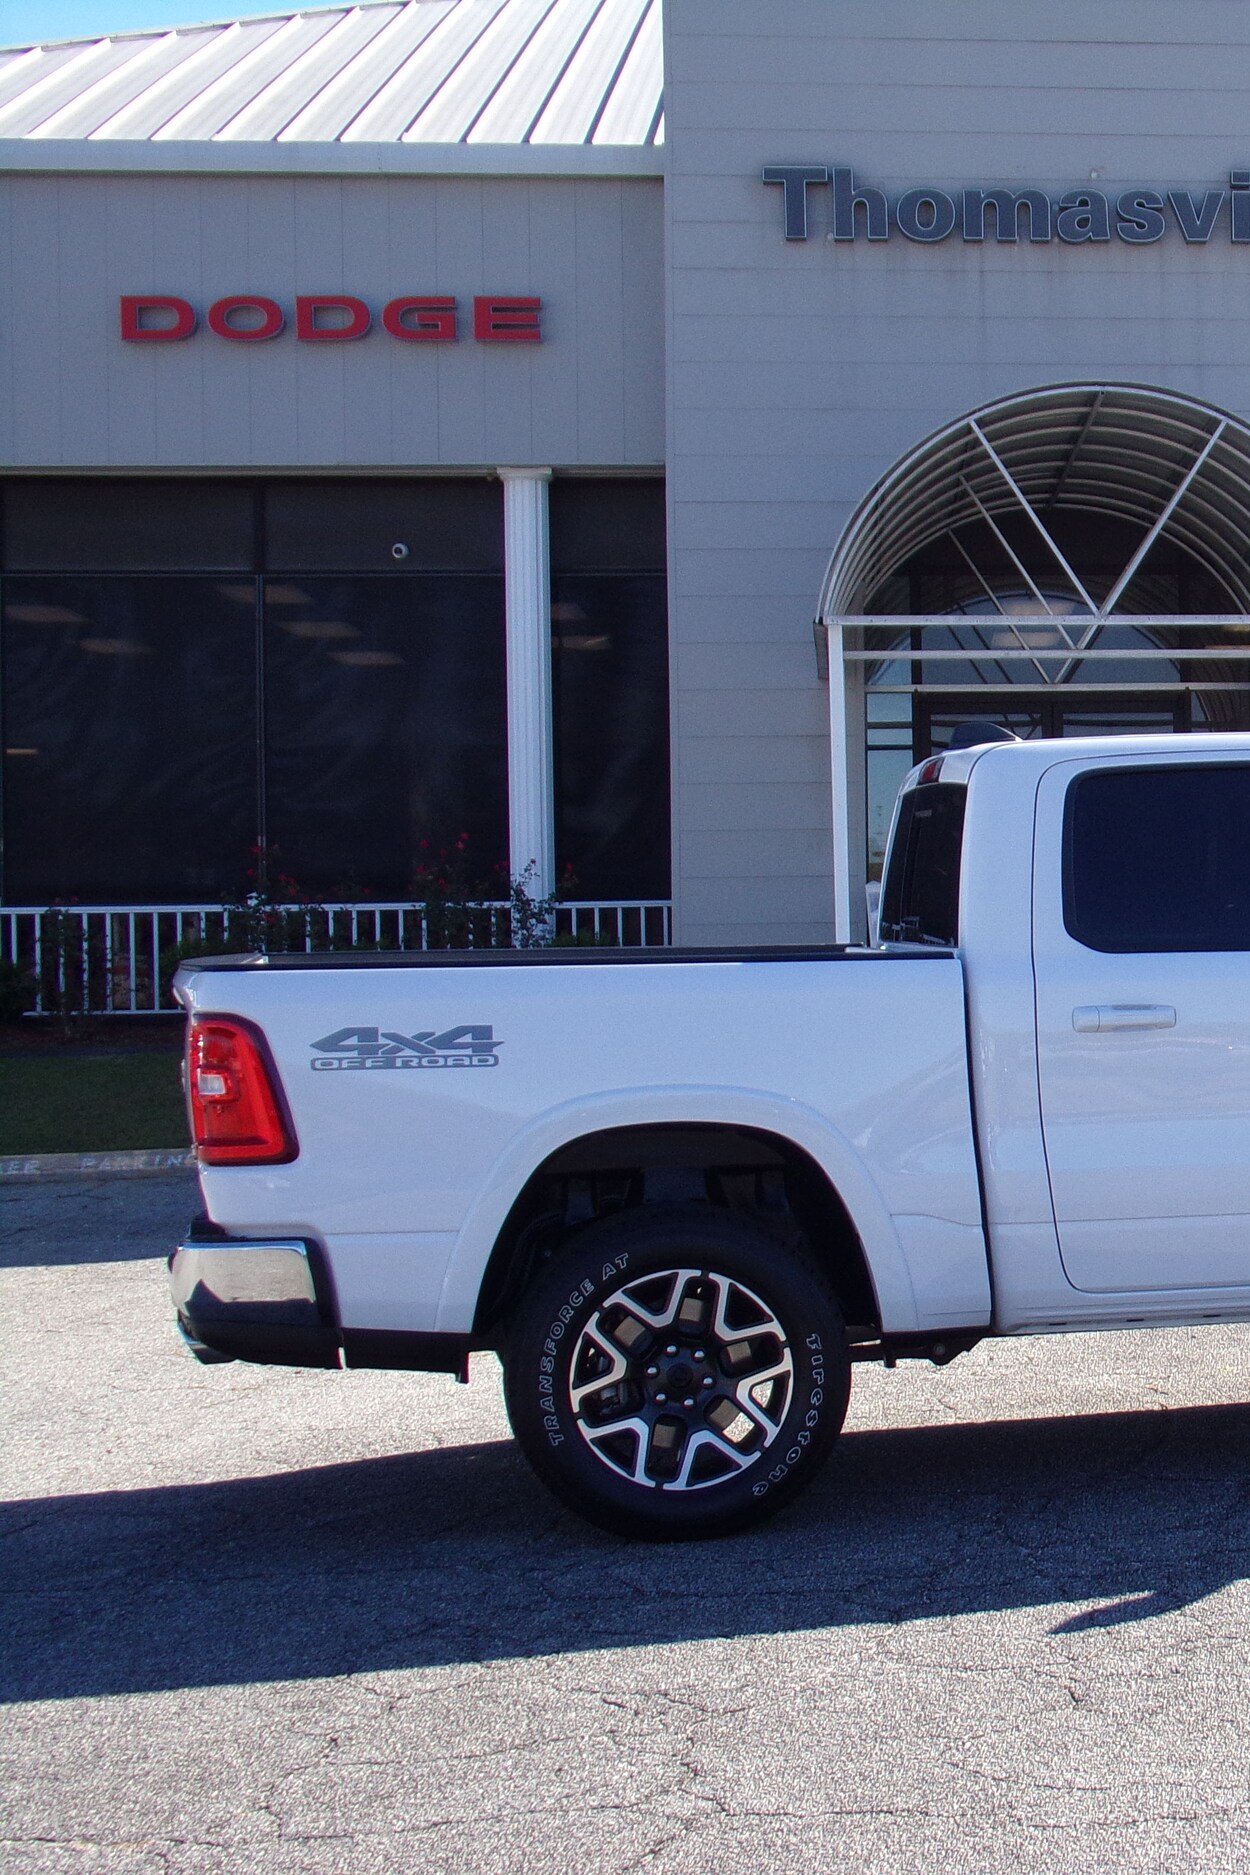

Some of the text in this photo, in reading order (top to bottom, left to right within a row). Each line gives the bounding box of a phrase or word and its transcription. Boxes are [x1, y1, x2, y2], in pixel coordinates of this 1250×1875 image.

[119, 294, 544, 344] DODGE
[313, 1054, 496, 1070] OFF ROAD
[538, 1253, 629, 1446] TRANSFORCE AT
